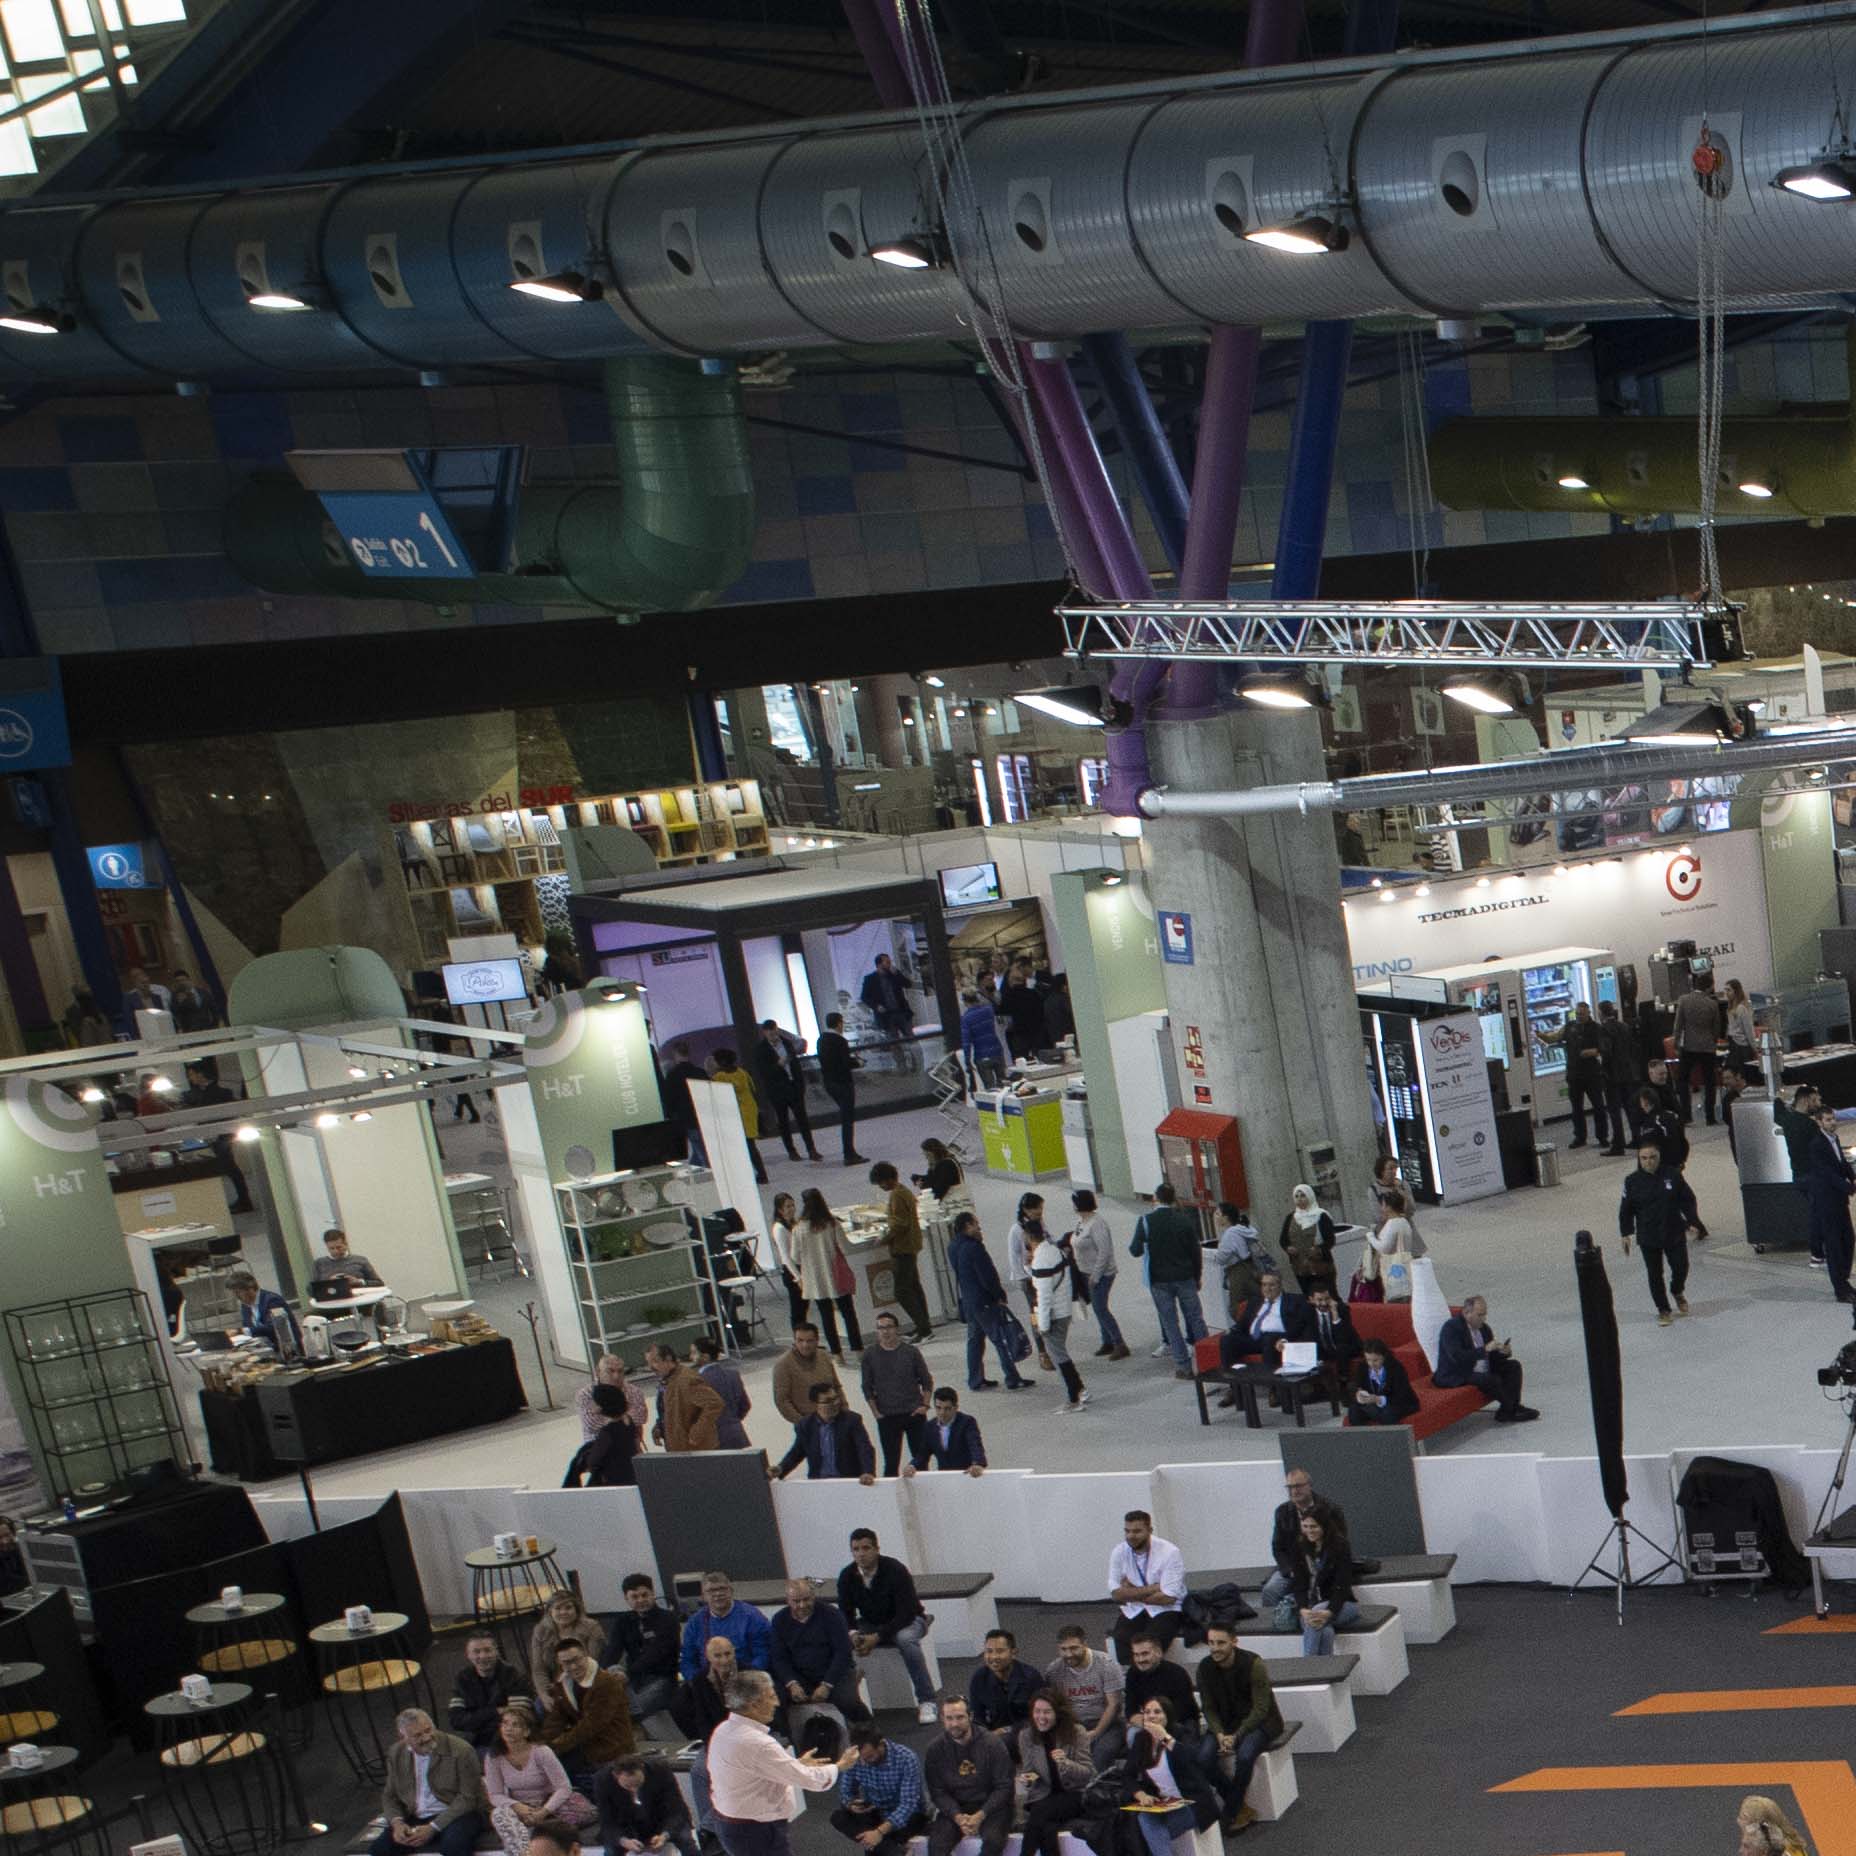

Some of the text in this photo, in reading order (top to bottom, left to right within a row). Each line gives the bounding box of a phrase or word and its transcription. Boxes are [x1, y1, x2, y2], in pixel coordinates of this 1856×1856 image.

[420, 512, 458, 567] 1
[480, 792, 512, 815] del
[520, 787, 573, 808] SUR
[1417, 894, 1551, 924] TECMADIGITAL
[1430, 1031, 1472, 1050] VenDis
[541, 1074, 585, 1101] H&T
[624, 1092, 639, 1114] CLUB
[32, 1168, 87, 1198] H&T
